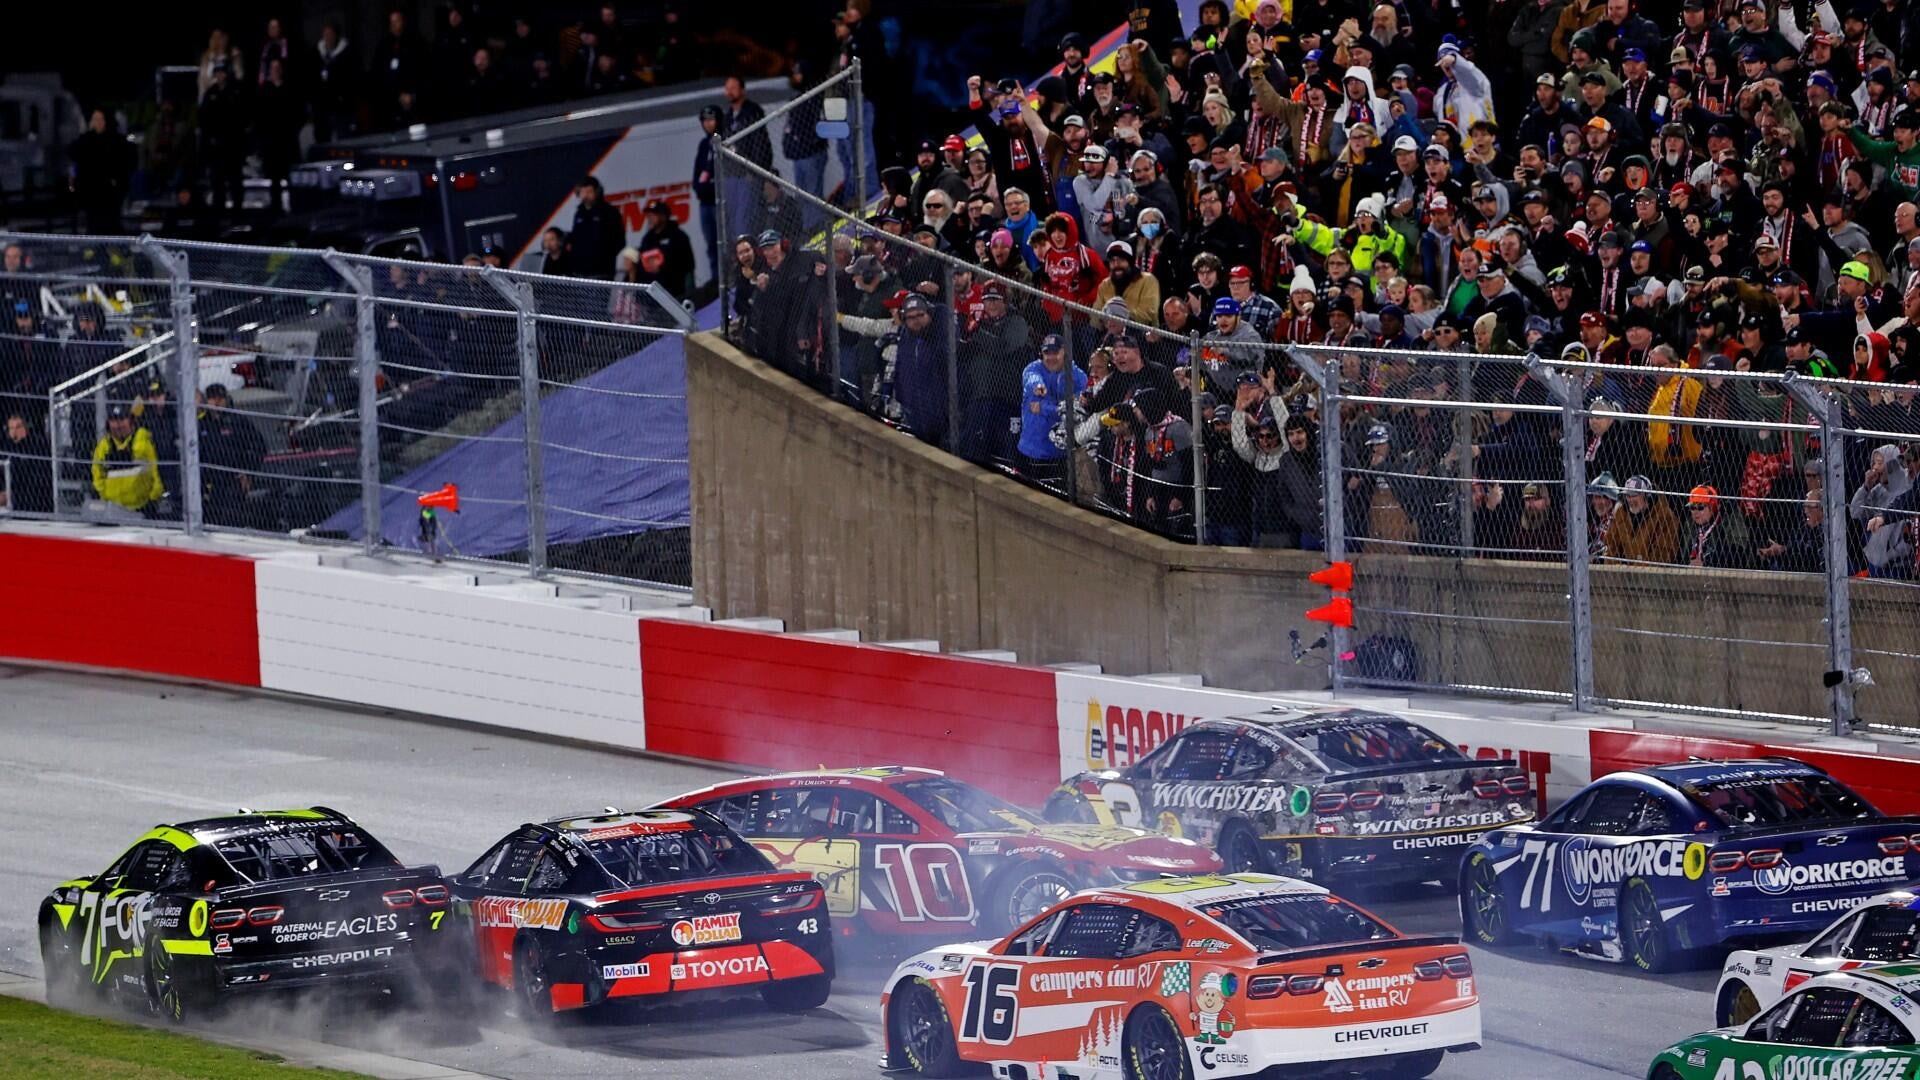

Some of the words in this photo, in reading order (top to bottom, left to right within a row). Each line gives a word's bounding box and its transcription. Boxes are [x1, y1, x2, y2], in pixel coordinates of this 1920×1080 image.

[1707, 767, 1814, 782] GAINRIDGE
[1151, 781, 1288, 813] WINCHESTER
[1391, 796, 1405, 806] The
[1406, 793, 1442, 804] American
[1443, 790, 1470, 805] Legend
[1507, 802, 1526, 817] 3
[235, 820, 343, 836] GAINRIDGE
[1353, 811, 1506, 836] WINCHESTER
[1006, 846, 1065, 859] GOODYEAR
[1569, 841, 1686, 885] WORKFORCE
[1766, 855, 1906, 887] WORKFORCE
[875, 843, 975, 922] 10
[1519, 839, 1558, 913] 71
[785, 885, 805, 894] XSE
[1791, 897, 1867, 914] CHEVRO
[80, 890, 101, 966] 7
[271, 921, 324, 935] FRATERNAL
[323, 913, 398, 939] EAGLES
[429, 911, 446, 930] 7
[694, 914, 739, 931] FAMILY
[796, 918, 818, 935] 43
[275, 933, 308, 945] ORDER
[309, 931, 324, 942] OF
[605, 935, 636, 944] LEGACY
[695, 927, 741, 943] DOLLAR
[604, 966, 636, 978] Mobil
[638, 964, 648, 975] 1
[687, 956, 770, 979] TOYOTA
[1030, 969, 1103, 999] campers
[1107, 964, 1136, 987] inn
[1136, 961, 1161, 989] RV
[1346, 973, 1416, 994] campers
[1455, 978, 1472, 999] 16
[958, 960, 1024, 1046] 16
[1359, 993, 1389, 1011] inn
[1388, 988, 1412, 1008] RV
[1334, 1022, 1430, 1044] CHEVROLET
[1099, 1055, 1119, 1067] ACTIO
[1215, 1053, 1249, 1064] CELSIUS
[1784, 1056, 1855, 1080] DOLLAR
[1855, 1056, 1912, 1080] TREE
